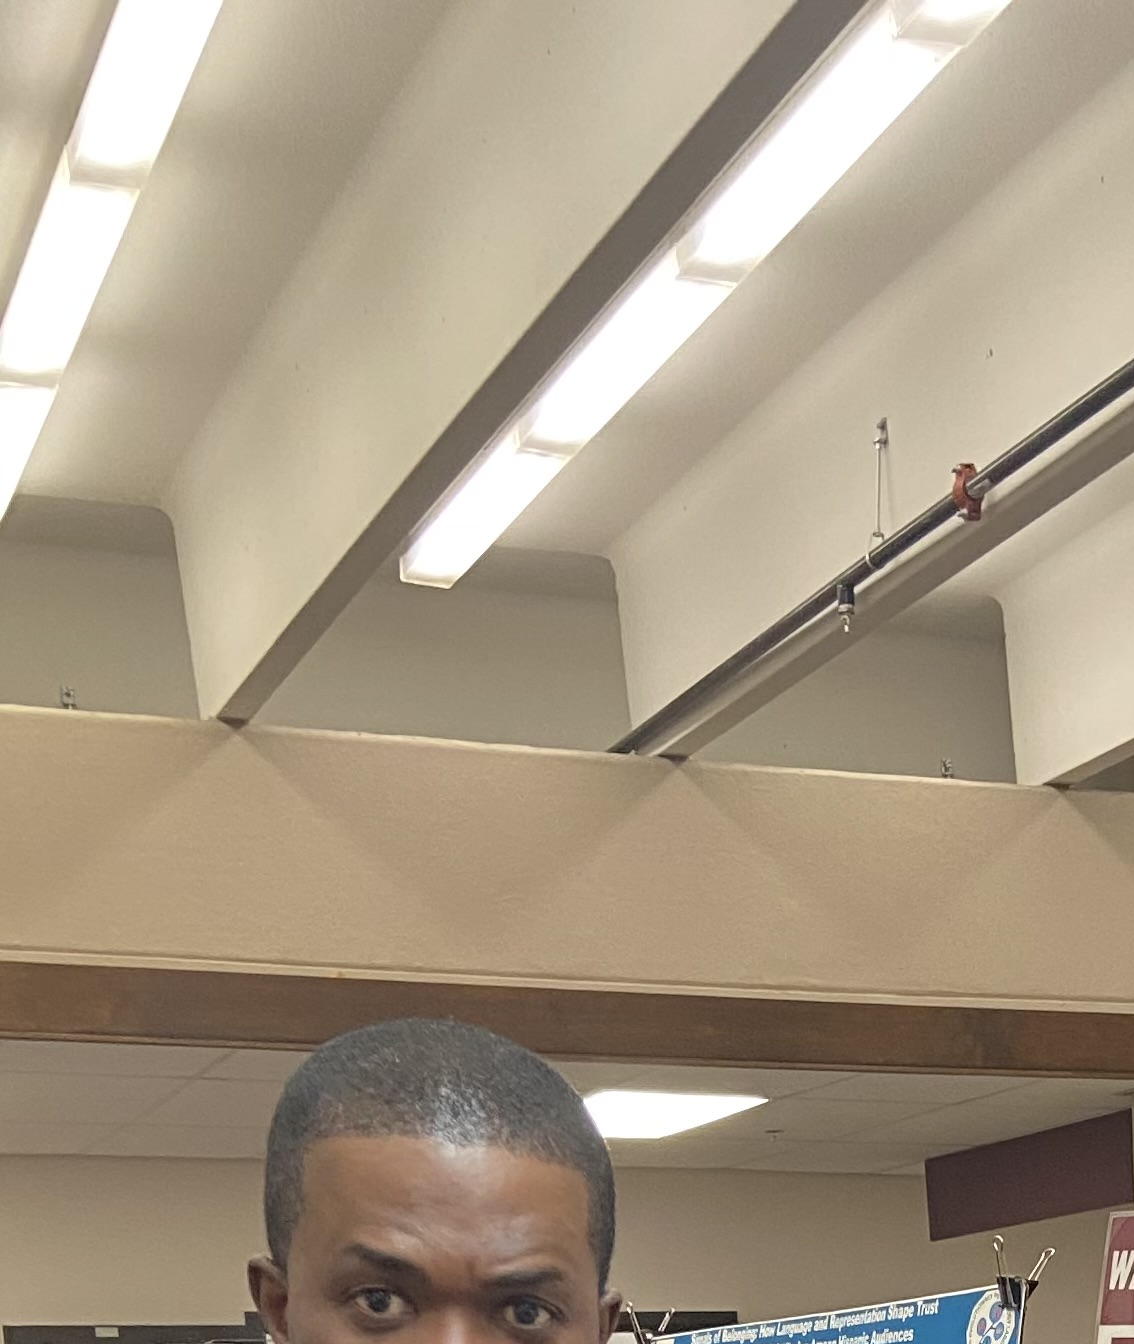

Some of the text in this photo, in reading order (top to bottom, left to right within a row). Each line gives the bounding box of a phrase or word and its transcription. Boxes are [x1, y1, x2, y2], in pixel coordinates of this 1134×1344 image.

[777, 1317, 813, 1338] Language
[813, 1315, 829, 1331] and
[830, 1307, 886, 1331] Representation
[887, 1303, 915, 1322] Shape
[917, 1300, 939, 1316] Trust
[871, 1328, 914, 1344] Audiences
